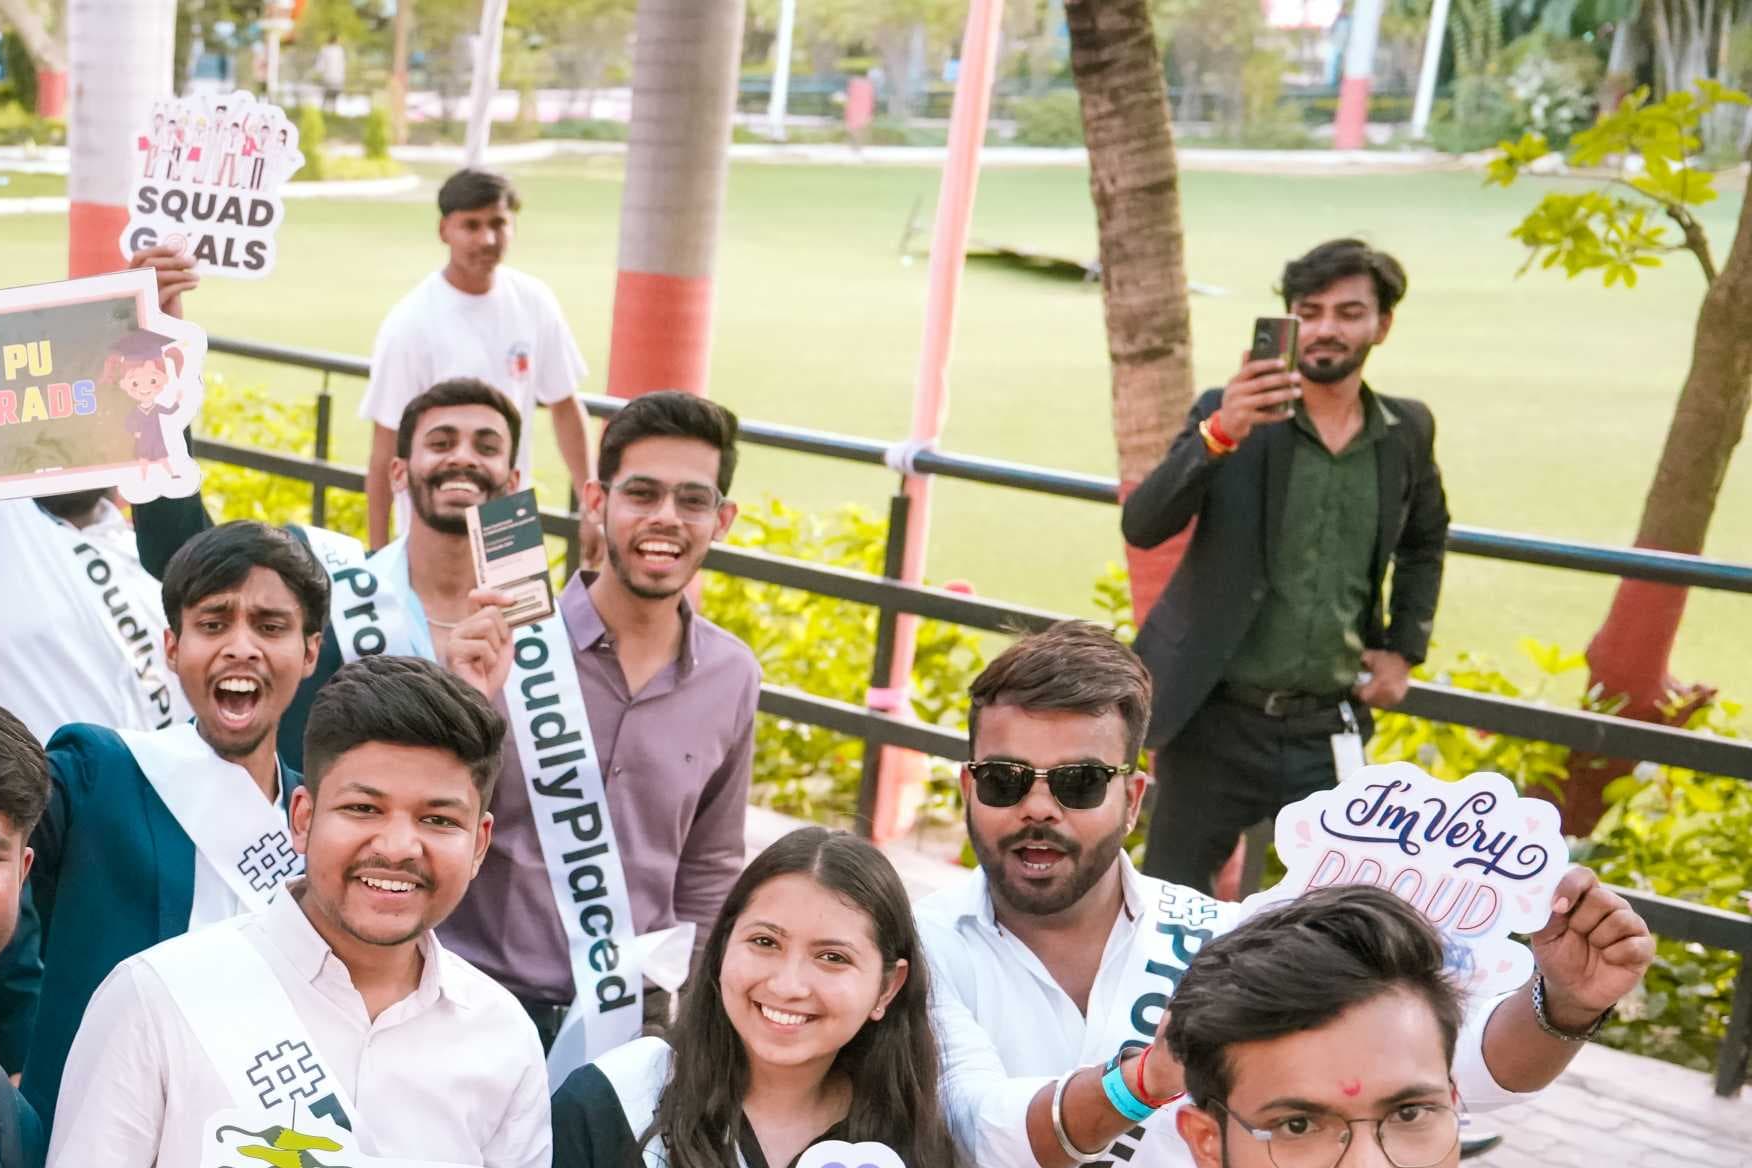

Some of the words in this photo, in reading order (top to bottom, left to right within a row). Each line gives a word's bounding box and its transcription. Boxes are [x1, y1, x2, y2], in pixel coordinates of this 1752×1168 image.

[136, 186, 274, 228] SQUAD
[3, 340, 53, 380] PU
[1320, 779, 1421, 856] I'm
[1423, 791, 1548, 881] Very
